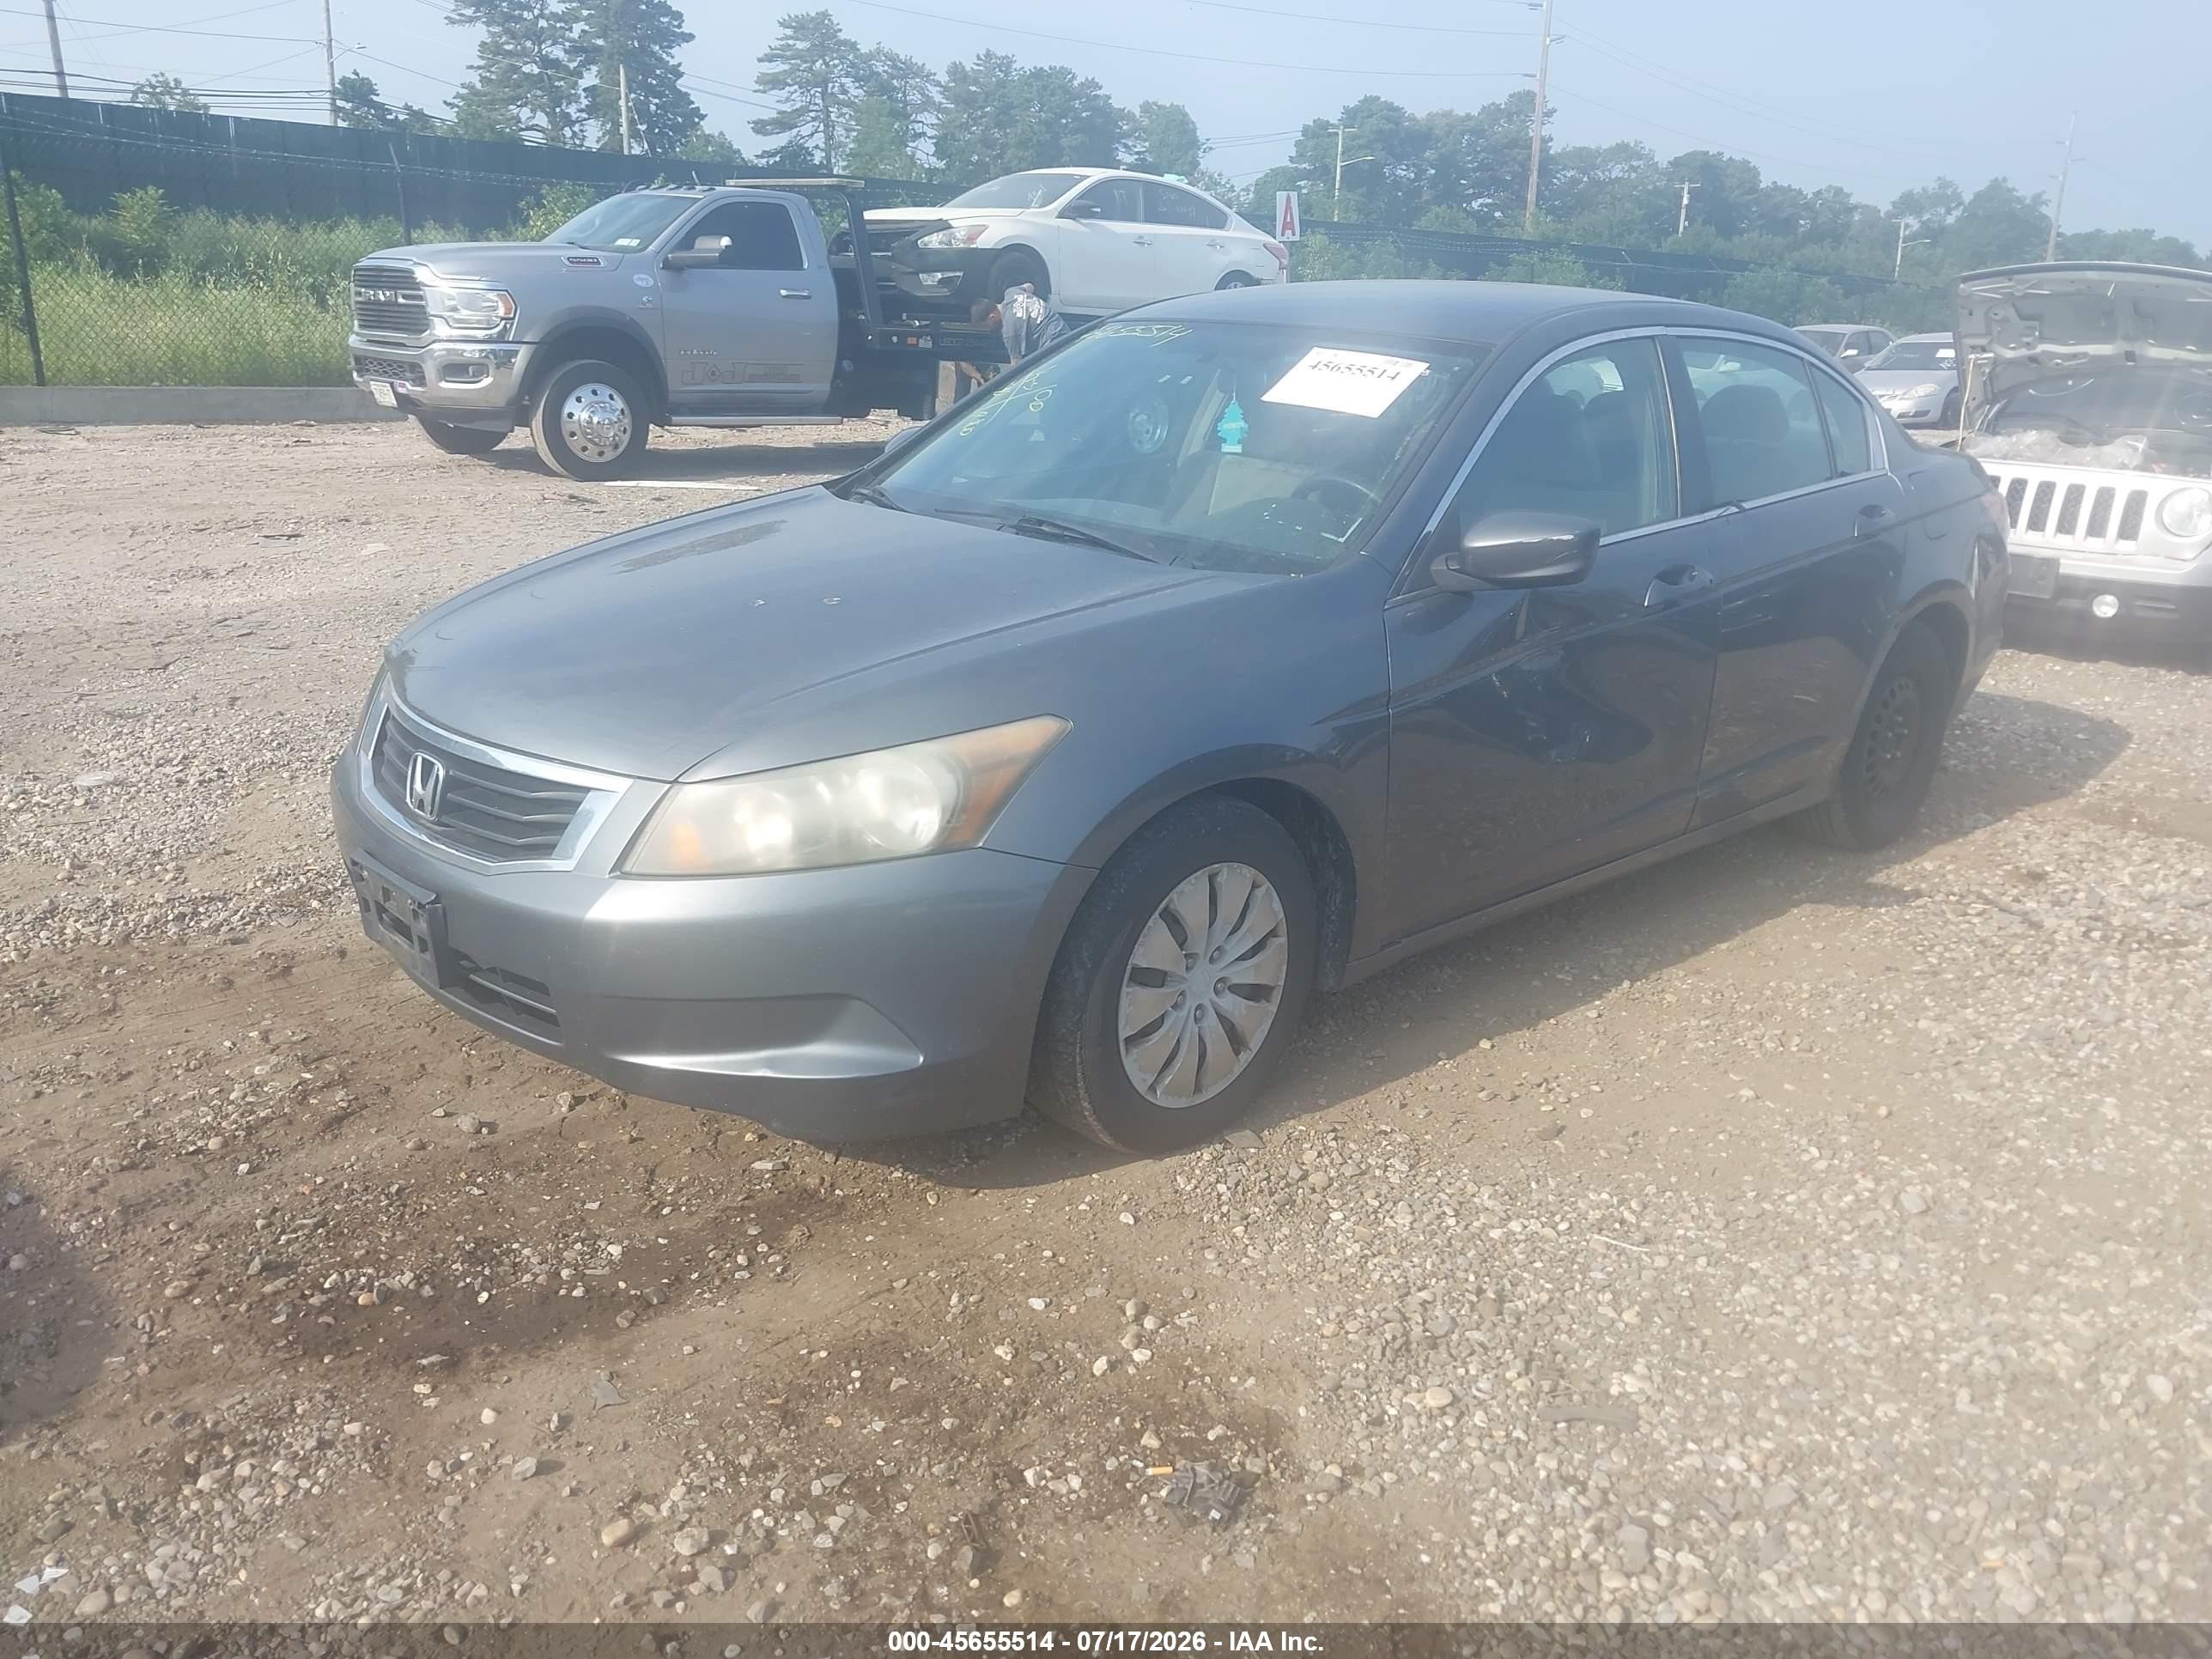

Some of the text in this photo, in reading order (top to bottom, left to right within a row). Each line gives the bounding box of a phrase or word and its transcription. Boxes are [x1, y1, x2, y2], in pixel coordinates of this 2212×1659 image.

[1281, 192, 1297, 237] A
[365, 289, 396, 302] RAM
[1308, 360, 1402, 381] 45655514
